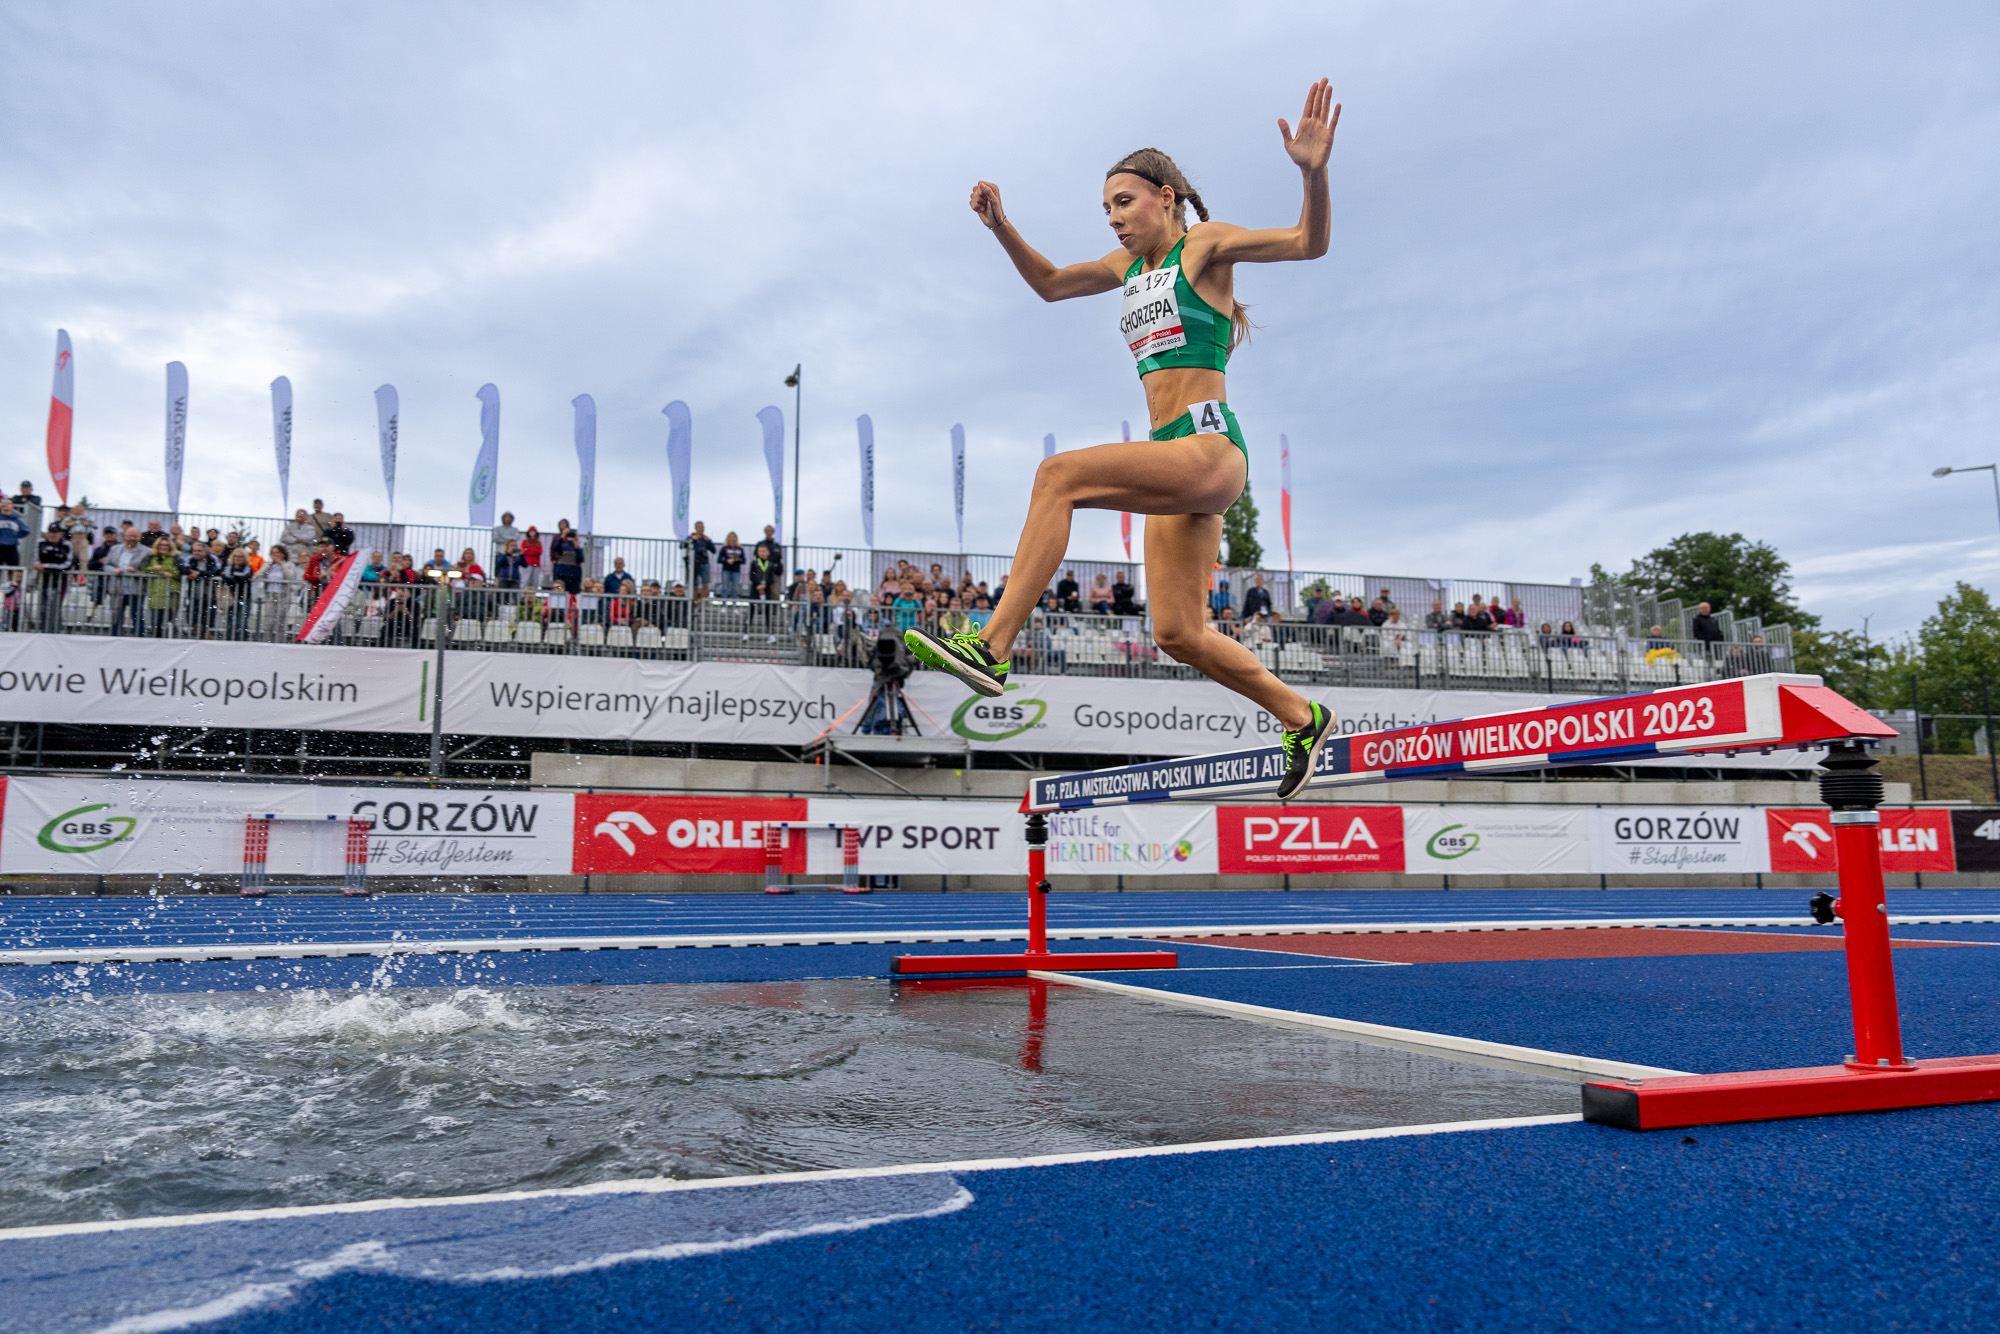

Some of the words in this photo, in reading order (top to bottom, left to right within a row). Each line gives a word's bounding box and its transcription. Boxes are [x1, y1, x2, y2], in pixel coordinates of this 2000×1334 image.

[1146, 271, 1171, 292] 197
[1120, 298, 1174, 335] CHORZĘPA
[1201, 402, 1220, 430] 4
[100, 668, 358, 705] Wielkopolskim
[490, 682, 658, 719] Wspieramy
[668, 690, 836, 725] najlepszych
[974, 705, 1023, 720] GBS
[1074, 704, 1246, 738] Gospodarczy
[1363, 727, 1453, 767] GORZÓW
[1458, 708, 1635, 756] WIELKOPOLSKI
[1643, 697, 1715, 736] 2023
[1045, 784, 1058, 800] 99.
[1059, 780, 1081, 799] PZLA
[1082, 772, 1150, 797] MISTRZOSTWA
[1152, 766, 1191, 789] POLSKI
[1194, 764, 1207, 784] W
[1209, 757, 1257, 783] LEKKIEJ
[62, 823, 112, 835] GBS
[902, 825, 1000, 849] SPORT
[1104, 822, 1120, 837] for
[1244, 817, 1379, 850] PZLA
[1615, 811, 1740, 839] GORZÓW
[1050, 842, 1131, 862] HEALTHIER
[1138, 843, 1170, 862] KIDS
[1439, 838, 1467, 846] GBS
